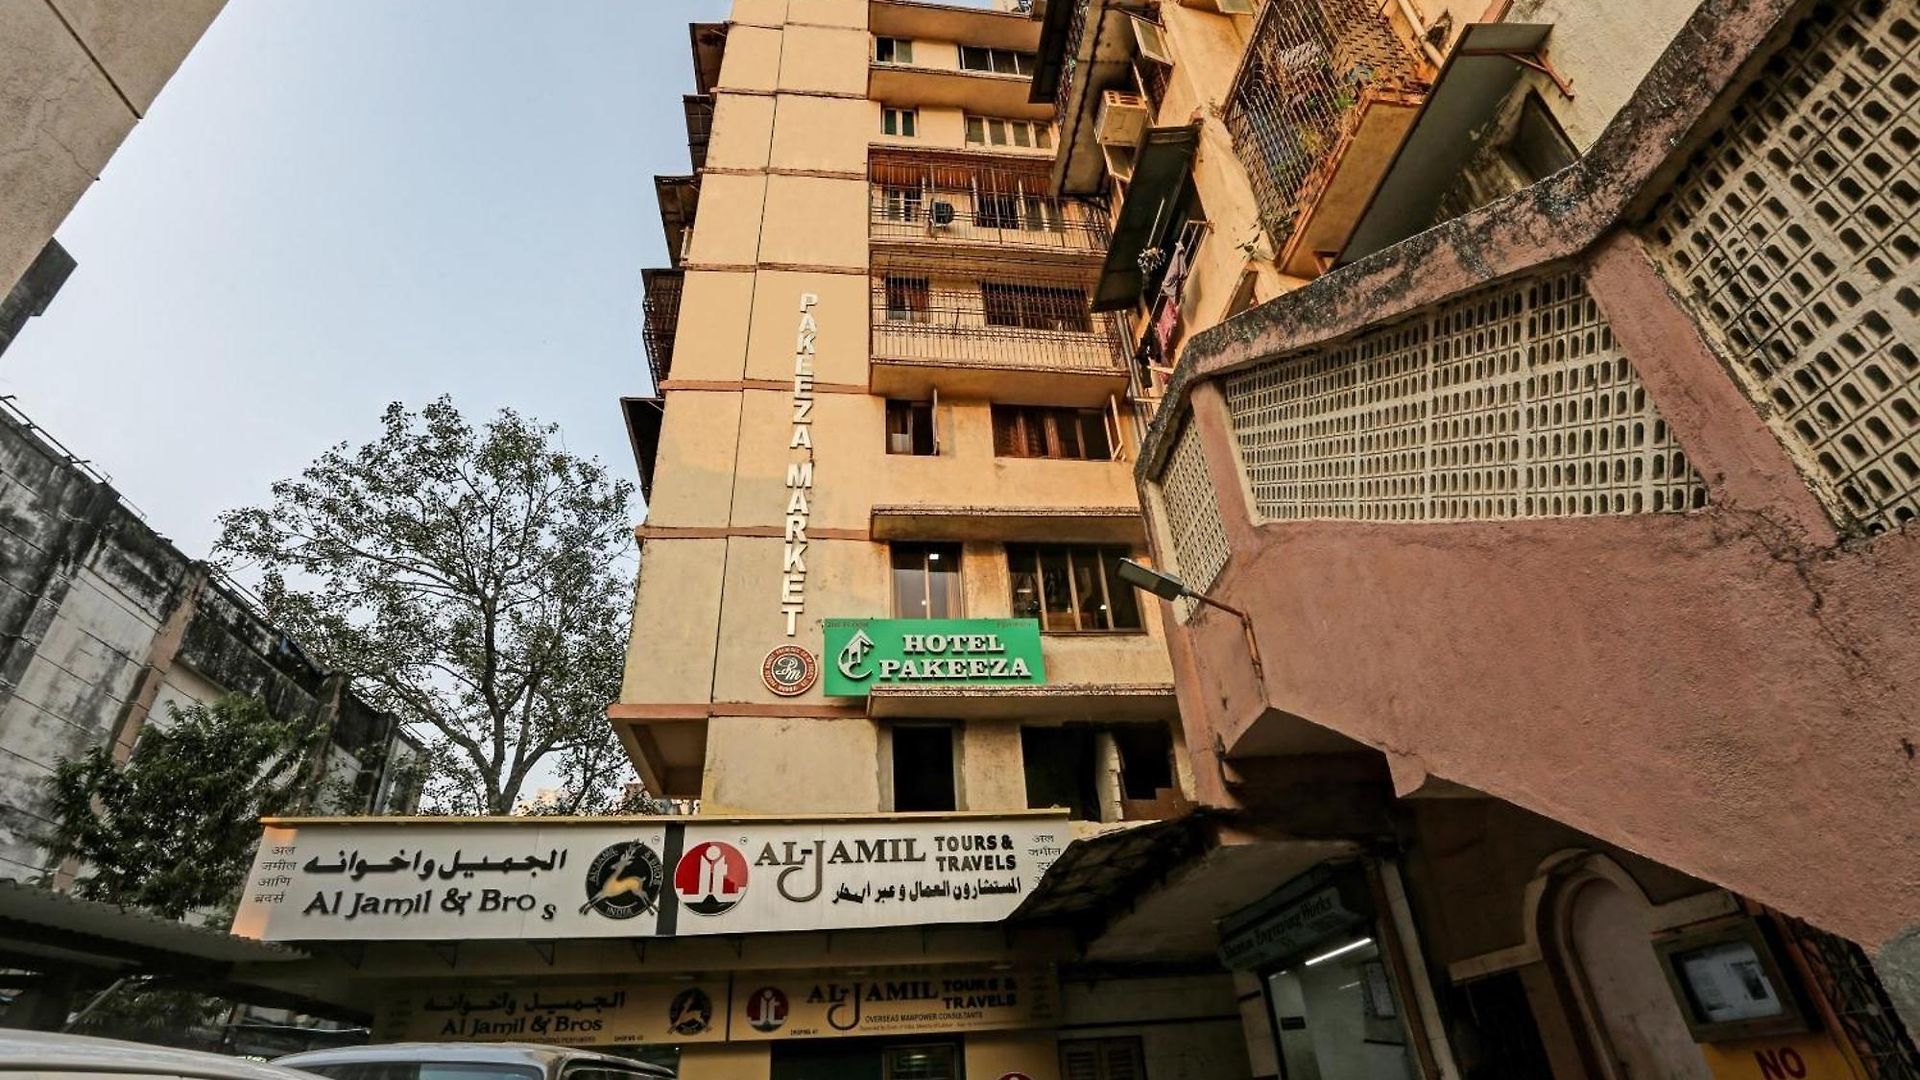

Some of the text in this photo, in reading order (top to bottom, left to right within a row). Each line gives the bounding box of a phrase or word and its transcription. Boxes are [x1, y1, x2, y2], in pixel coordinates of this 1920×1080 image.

[789, 293, 818, 449] PAKEEZA
[781, 462, 813, 637] MARKET
[902, 634, 1004, 653] HOTEL
[879, 658, 1032, 680] PAKEEZA
[933, 834, 1014, 852] TOURS &
[438, 848, 568, 881] الجميل
[754, 837, 927, 902] AL-JAMIL
[935, 854, 1017, 872] TRAVELS
[303, 887, 557, 921] Al Jamil & Bros
[942, 977, 998, 991] TOURS
[942, 992, 1018, 1010] TRAVELS
[441, 1016, 603, 1038] Al Jamil & Bros
[1755, 1047, 1807, 1080] NO
